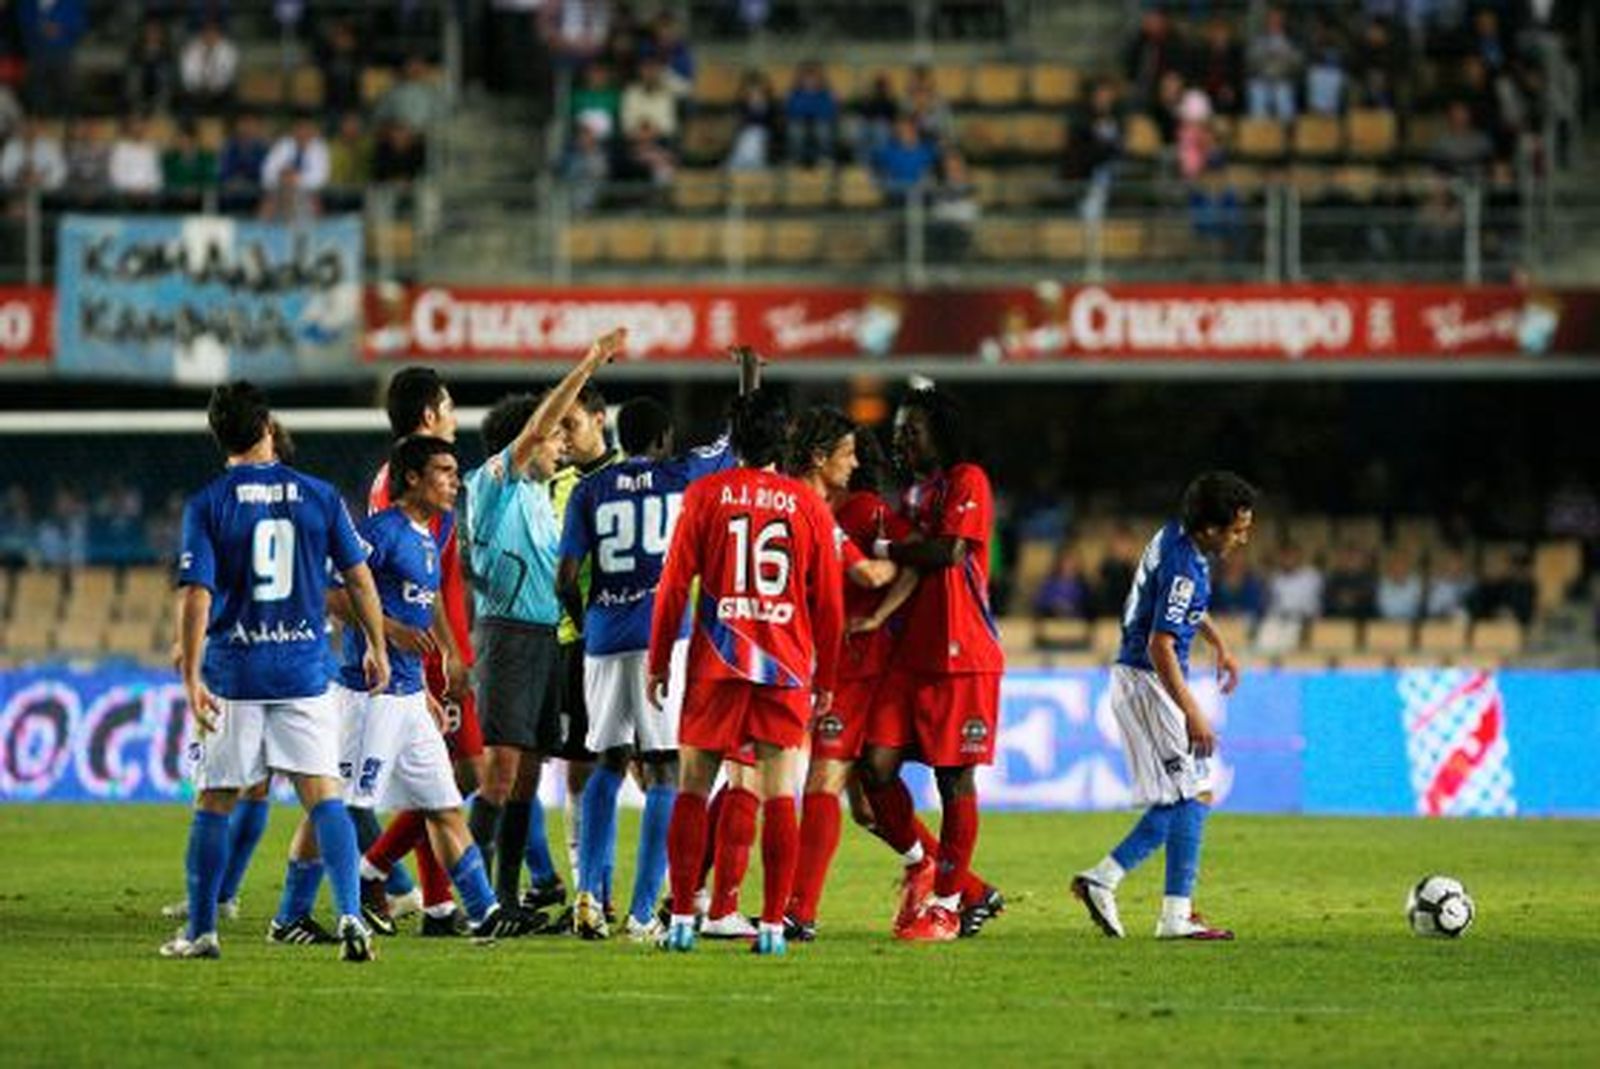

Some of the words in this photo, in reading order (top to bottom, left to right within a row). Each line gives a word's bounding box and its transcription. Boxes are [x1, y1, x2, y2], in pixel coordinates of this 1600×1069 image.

[411, 289, 693, 358] Cruzcampo
[1070, 286, 1351, 358] Cruzcampo
[596, 494, 682, 573] 24
[755, 487, 797, 513] RIOS
[253, 519, 294, 602] 9
[728, 513, 792, 597] 16
